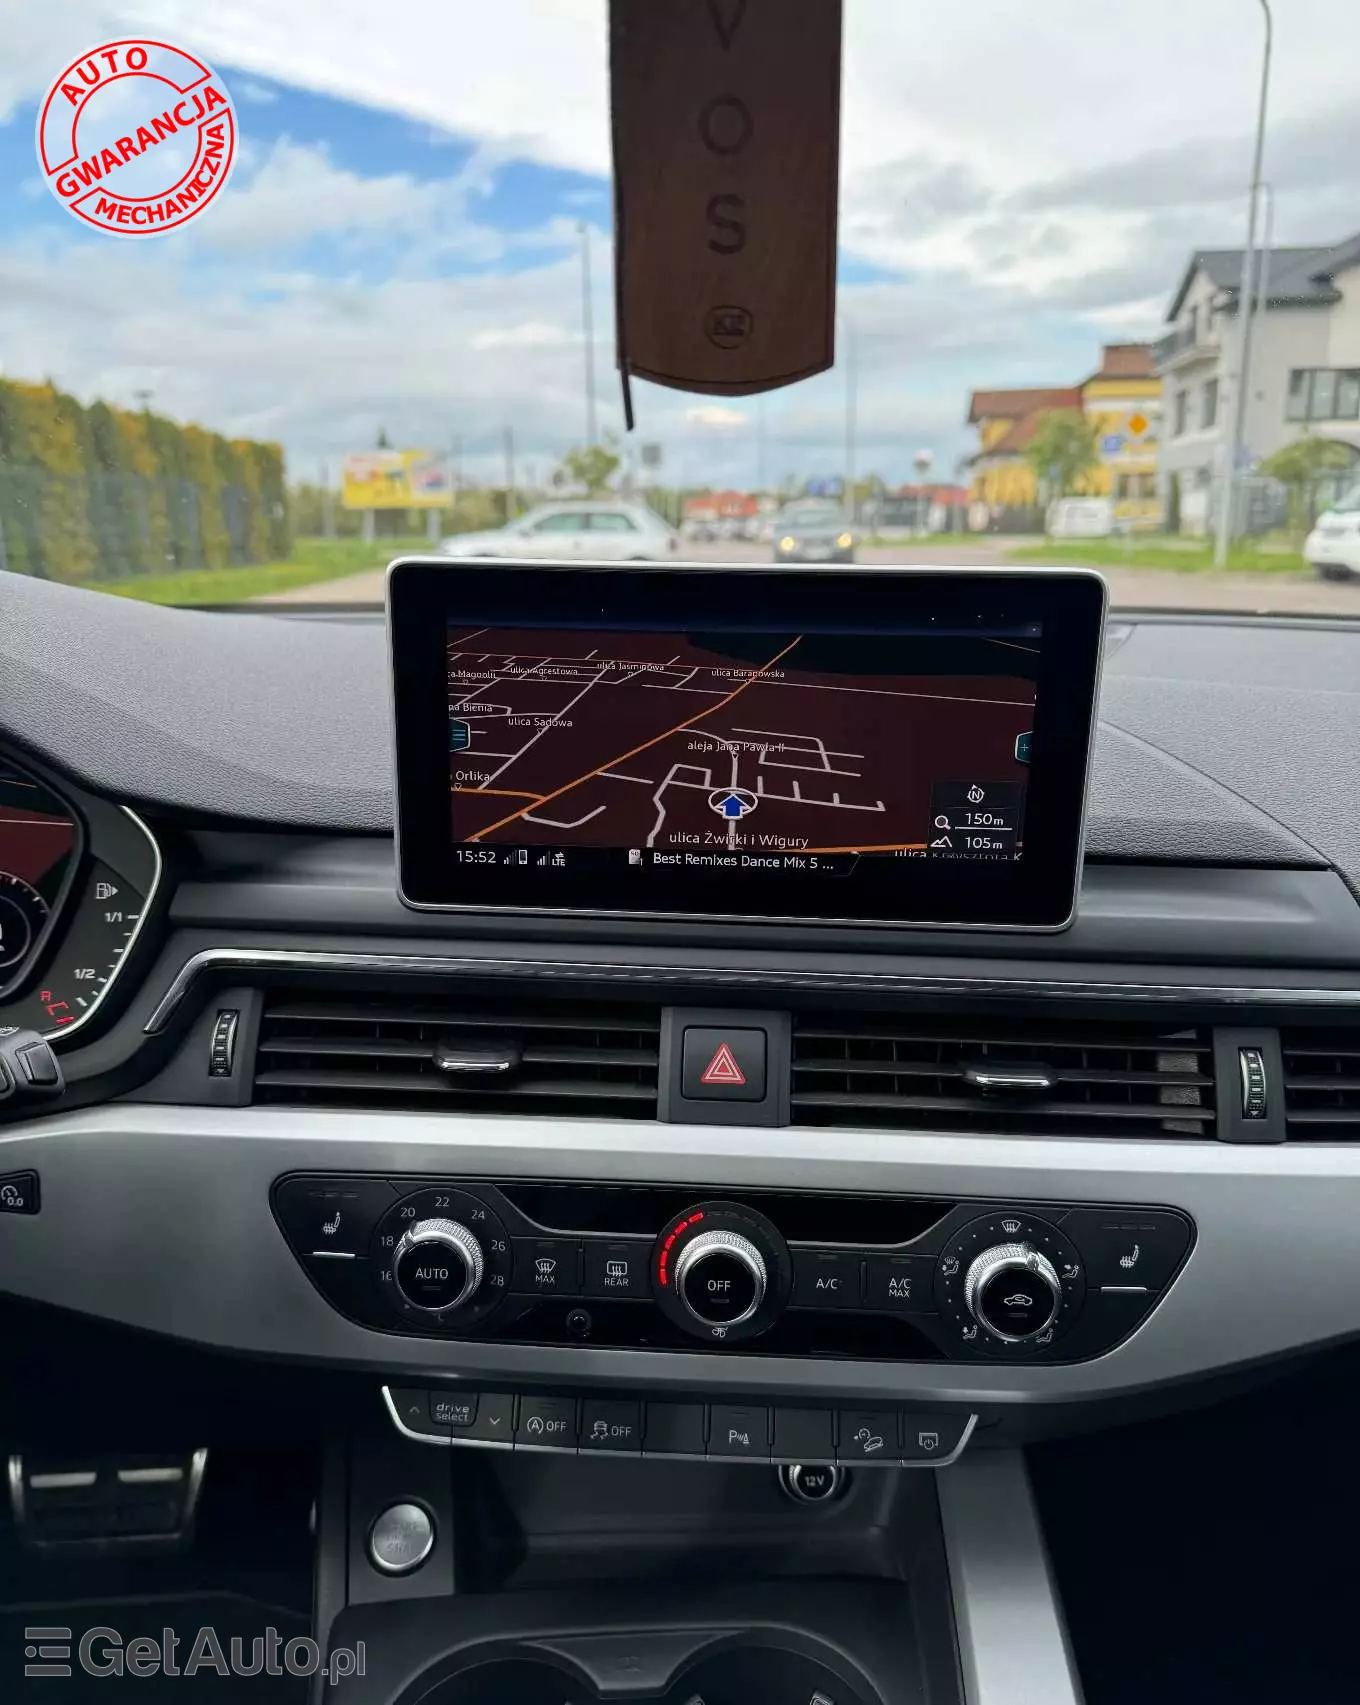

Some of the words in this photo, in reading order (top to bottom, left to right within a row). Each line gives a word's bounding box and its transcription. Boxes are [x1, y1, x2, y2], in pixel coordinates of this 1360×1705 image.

[711, 669, 731, 677] ulica
[508, 717, 531, 726] ulica
[533, 717, 573, 727] Sadowa
[687, 741, 713, 752] aleja
[455, 771, 490, 781] Orlika
[669, 832, 700, 843] ulica
[751, 834, 755, 845] i
[759, 834, 809, 849] Wigury
[456, 850, 497, 863] 15:52
[551, 858, 566, 866] LTE
[653, 852, 682, 865] Best
[685, 853, 738, 867] Remixes
[741, 855, 780, 868] Dance
[784, 857, 806, 869] Mix
[809, 857, 818, 869] 5
[105, 912, 123, 923] 1/1
[73, 968, 96, 980] 1/2
[435, 1196, 450, 1208] 22
[400, 1207, 416, 1218] 20
[471, 1209, 485, 1220] 24
[381, 1236, 394, 1247] 18
[491, 1239, 506, 1251] 26
[380, 1270, 393, 1281] 16
[415, 1267, 449, 1279] AUTO
[490, 1274, 505, 1287] 28
[535, 1274, 556, 1284] MAX
[604, 1277, 629, 1287] REAR
[816, 1278, 839, 1290] A/C
[889, 1278, 912, 1289] A/C
[707, 1279, 731, 1292] OFF
[888, 1289, 910, 1298] MAX
[436, 1403, 470, 1413] drive
[435, 1412, 469, 1422] select
[546, 1421, 566, 1432] OFF
[611, 1426, 631, 1436] OFF
[805, 1475, 824, 1486] 12V
